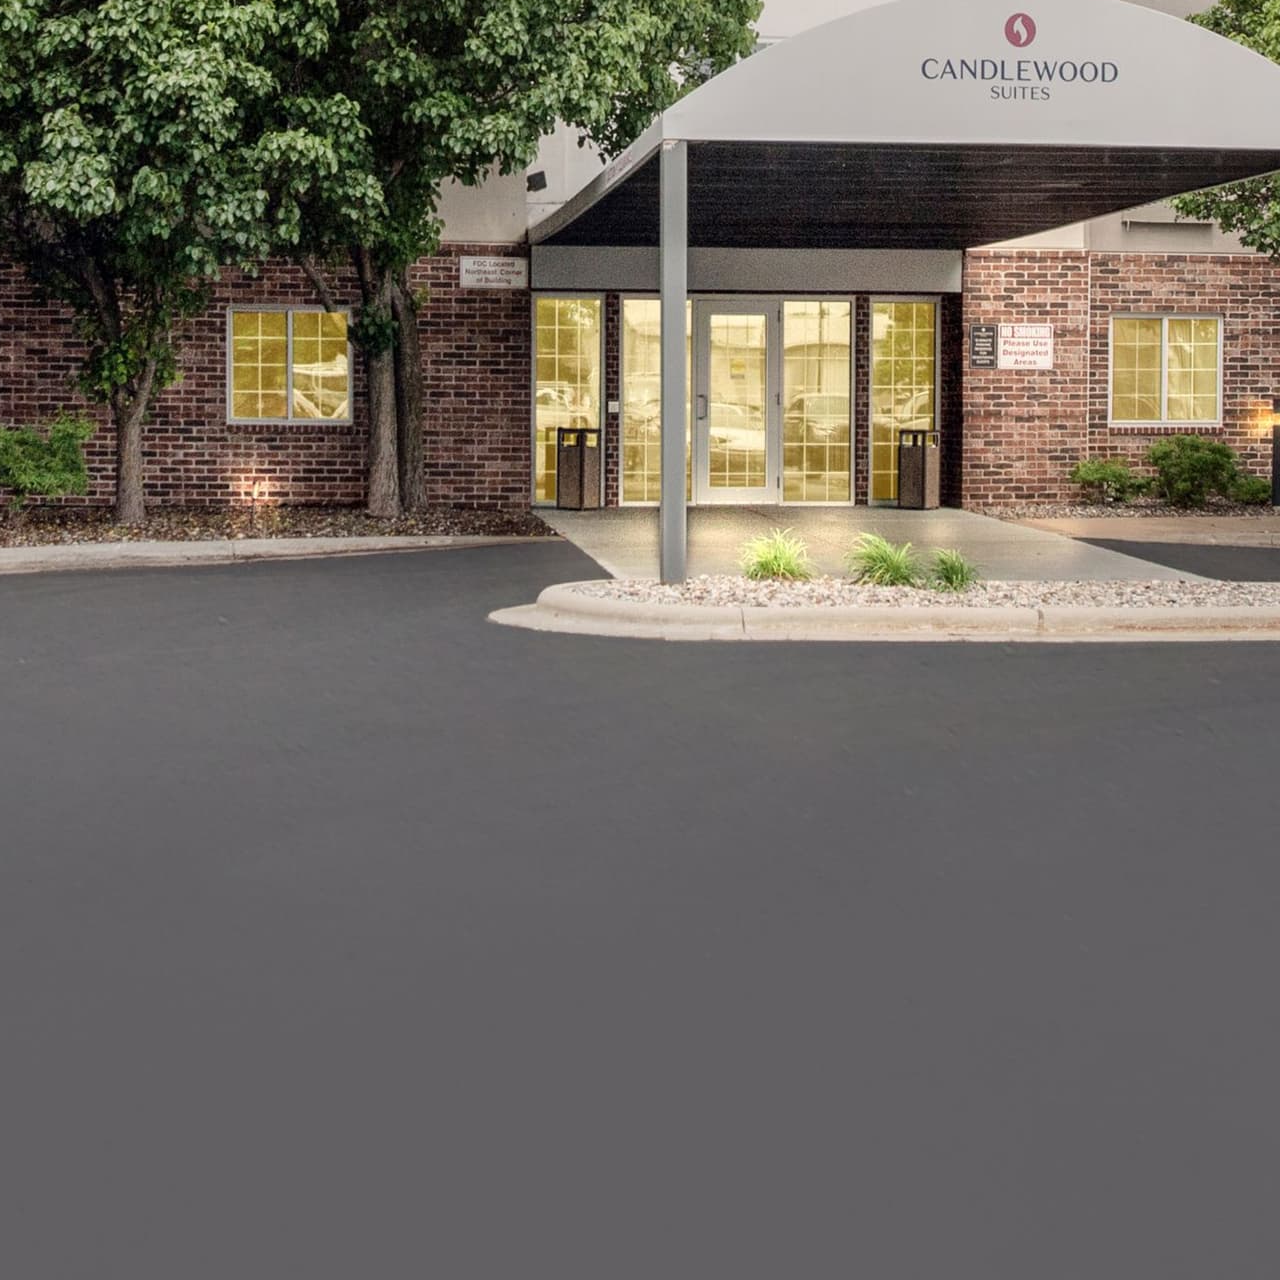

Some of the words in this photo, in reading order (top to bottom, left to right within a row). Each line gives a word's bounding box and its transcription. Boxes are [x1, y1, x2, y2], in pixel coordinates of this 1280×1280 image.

[921, 58, 1119, 83] CANDLEWOOD
[990, 85, 1050, 100] SUITES
[484, 277, 511, 285] Building
[1002, 349, 1048, 357] Designated
